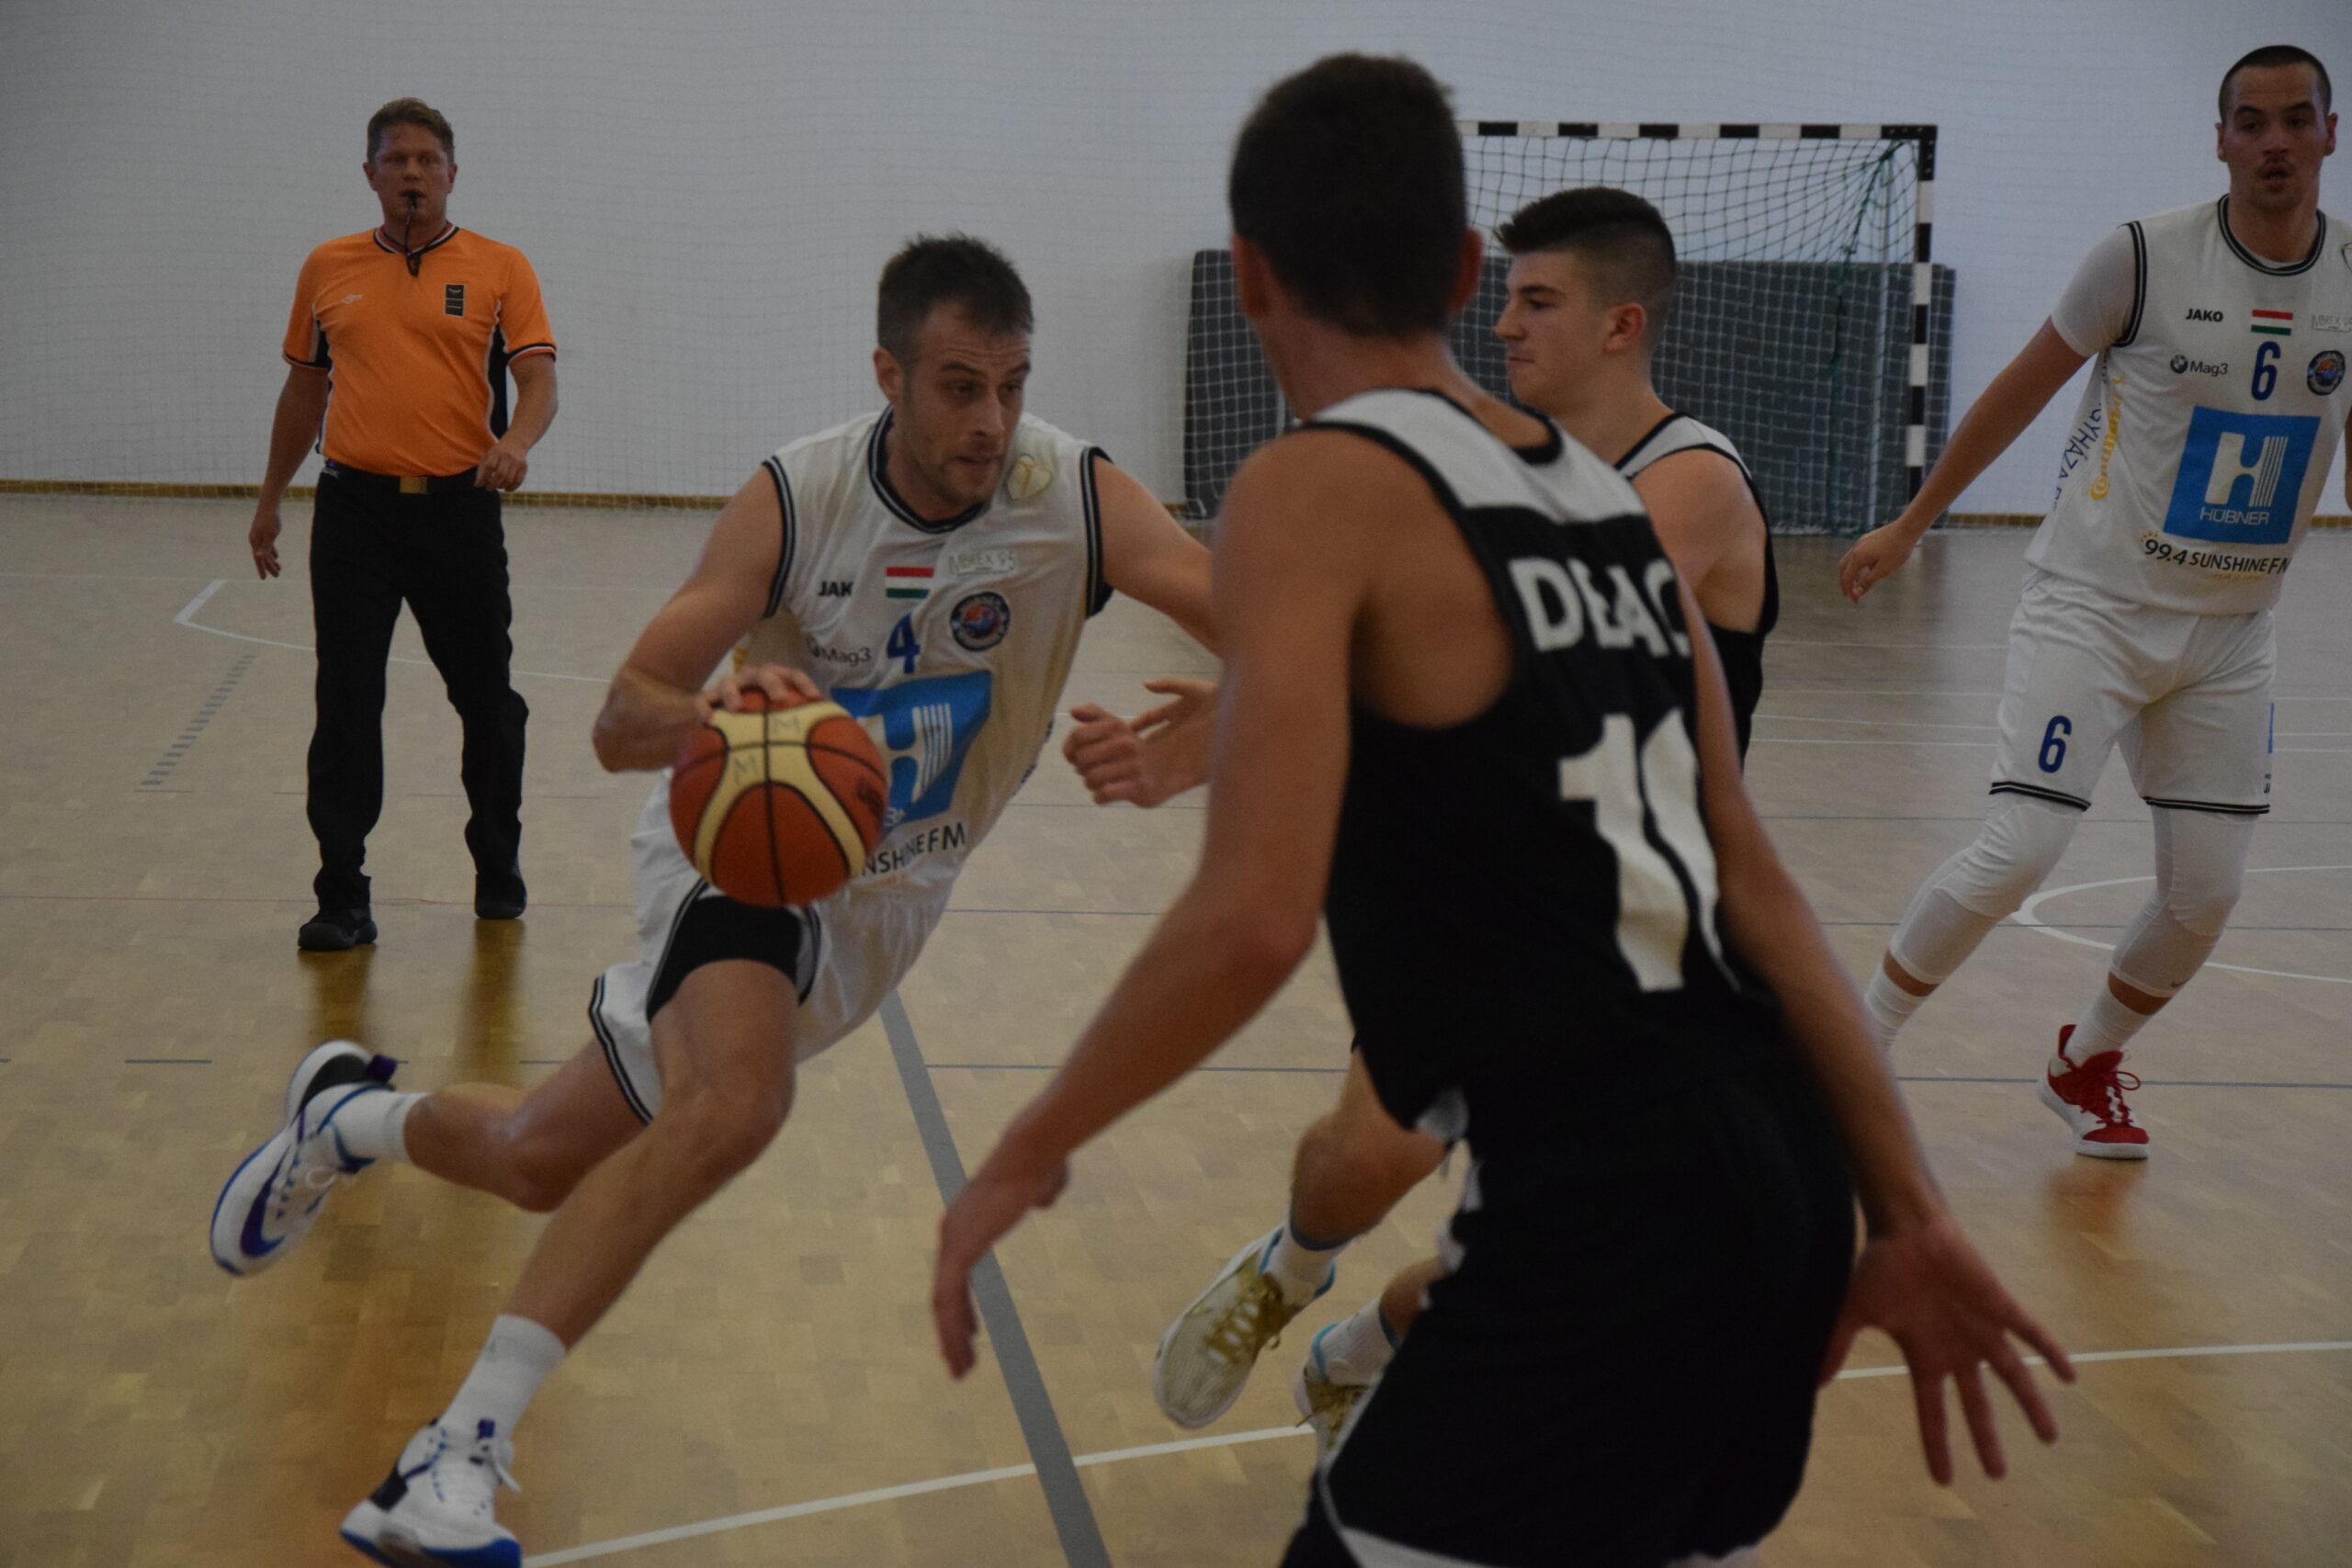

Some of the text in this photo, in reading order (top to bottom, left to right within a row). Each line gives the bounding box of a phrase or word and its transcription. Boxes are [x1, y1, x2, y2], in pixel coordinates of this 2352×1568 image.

[2185, 308, 2224, 323] JAKO
[2188, 359, 2229, 377] Mag3
[2250, 341, 2282, 401] 6
[2143, 537, 2188, 566] 99.4
[818, 581, 854, 597] JAK
[886, 612, 922, 674] 4
[2037, 715, 2073, 773] 6
